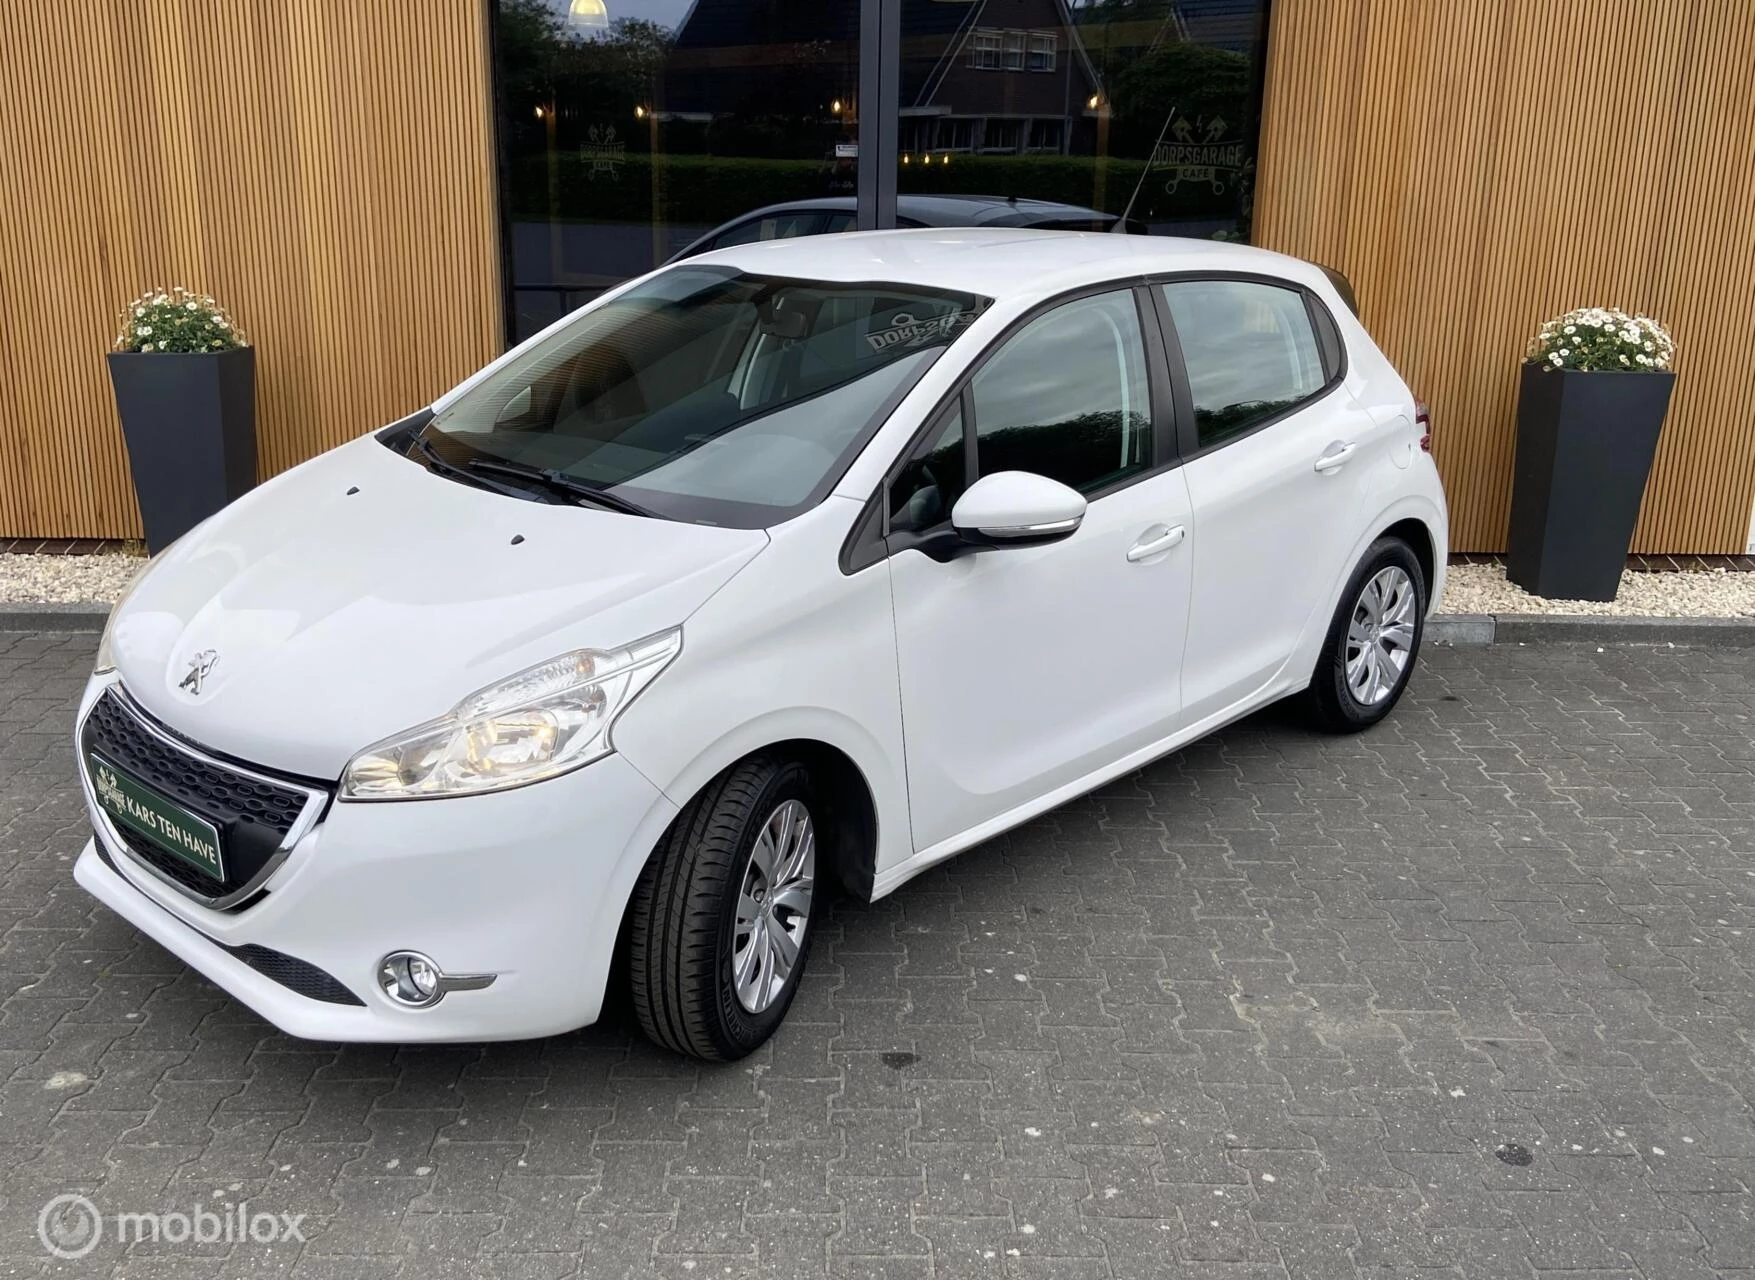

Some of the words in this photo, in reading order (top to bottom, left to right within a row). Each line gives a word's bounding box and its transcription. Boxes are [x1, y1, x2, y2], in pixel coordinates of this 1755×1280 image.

[1153, 144, 1244, 166] DORPSGARAGE
[126, 796, 157, 828] KARS
[157, 814, 182, 844] TEN
[183, 829, 217, 865] HAVE
[722, 986, 752, 1043] ICHELIN
